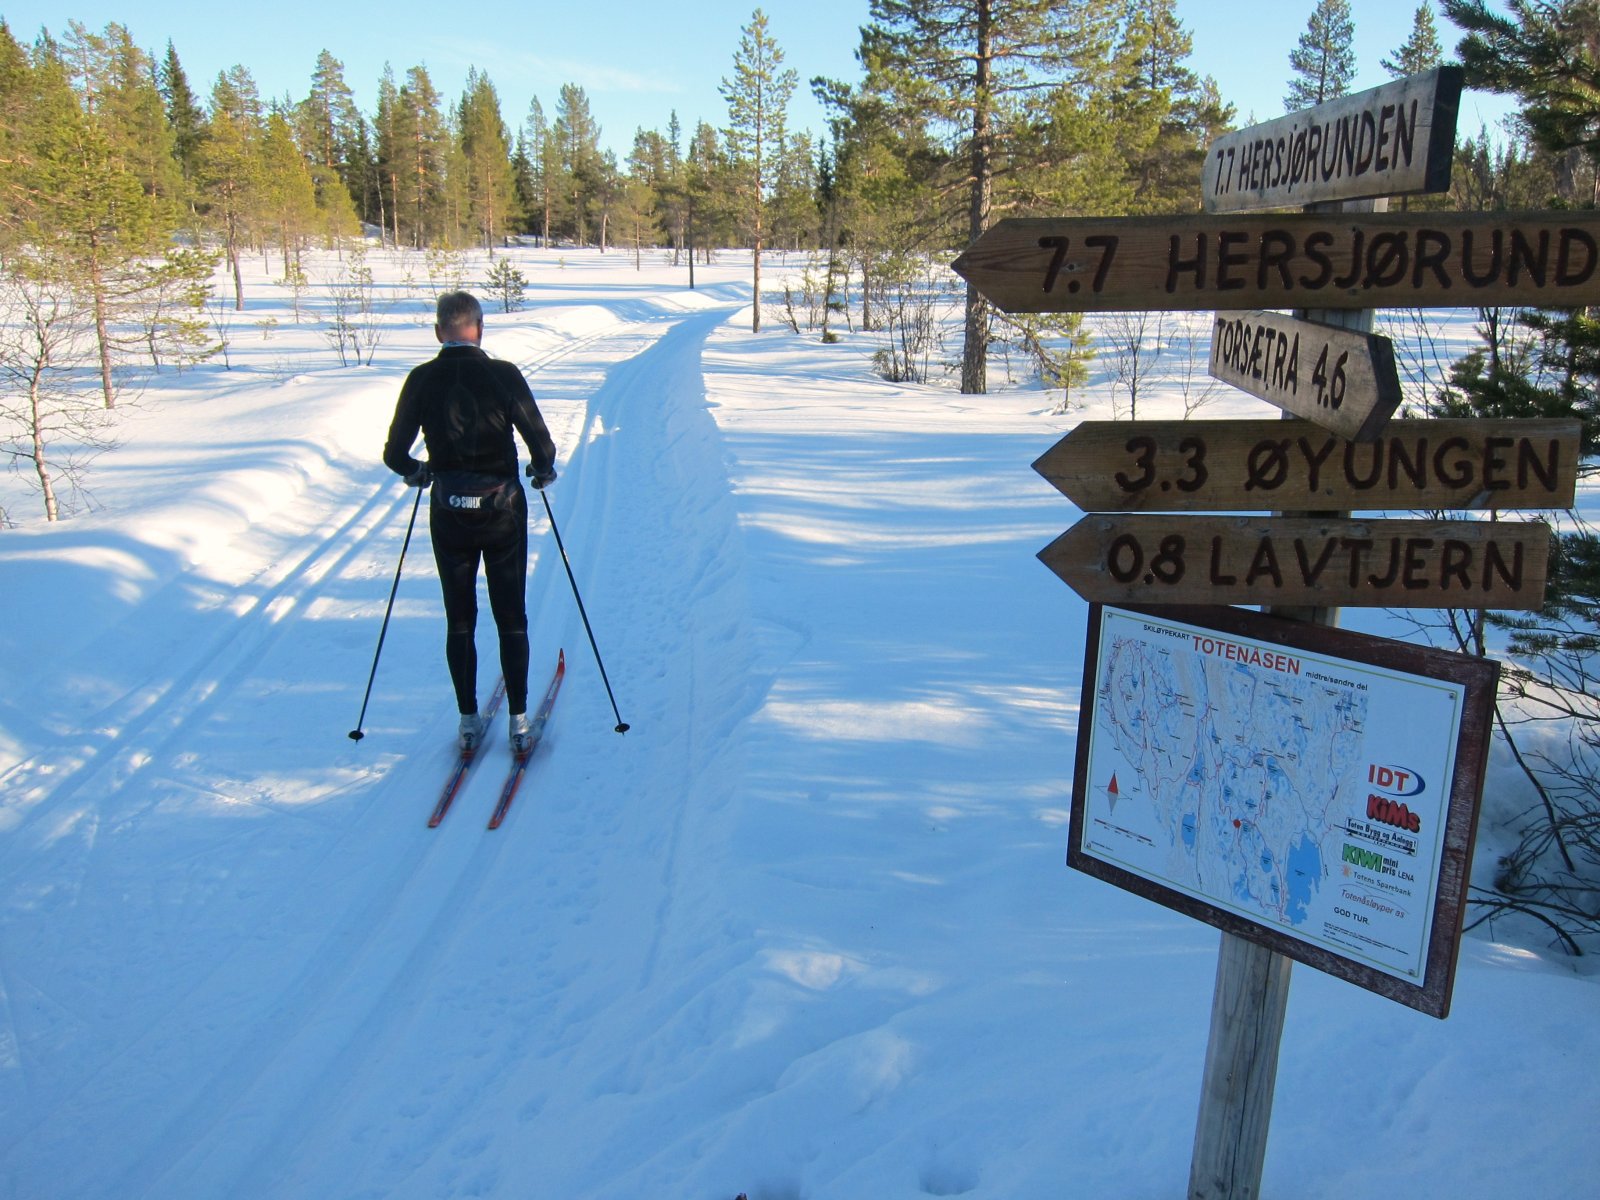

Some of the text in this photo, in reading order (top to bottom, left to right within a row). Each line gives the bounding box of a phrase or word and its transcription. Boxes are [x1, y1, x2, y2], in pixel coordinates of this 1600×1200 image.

[1215, 99, 1418, 195] 7.7 HERSJØRUNDEN
[1038, 227, 1598, 294] 7.7 HERSJØRUND
[1215, 318, 1349, 410] TORSÆTRA 4.6
[1114, 436, 1559, 493] 3.3 ØYUNGEN
[1107, 533, 1524, 592] 0.8 LAVTJERN
[1143, 624, 1300, 676] SKILØYPEKART TOTENÅSEN
[1305, 670, 1368, 692] midtre/søndre del
[1368, 764, 1410, 792] IDT
[1347, 818, 1364, 831] Toten
[1365, 824, 1380, 839] Bygg
[1382, 832, 1390, 841] og
[1342, 843, 1384, 873] KIWI
[1383, 856, 1399, 869] mini
[1354, 871, 1375, 885] Totens
[1376, 879, 1412, 897] Sparebank
[1382, 866, 1415, 882] pris LENA
[1333, 906, 1371, 926] GOD TUR.
[1341, 888, 1395, 915] Totenåsløyper
[1395, 909, 1405, 919] as
